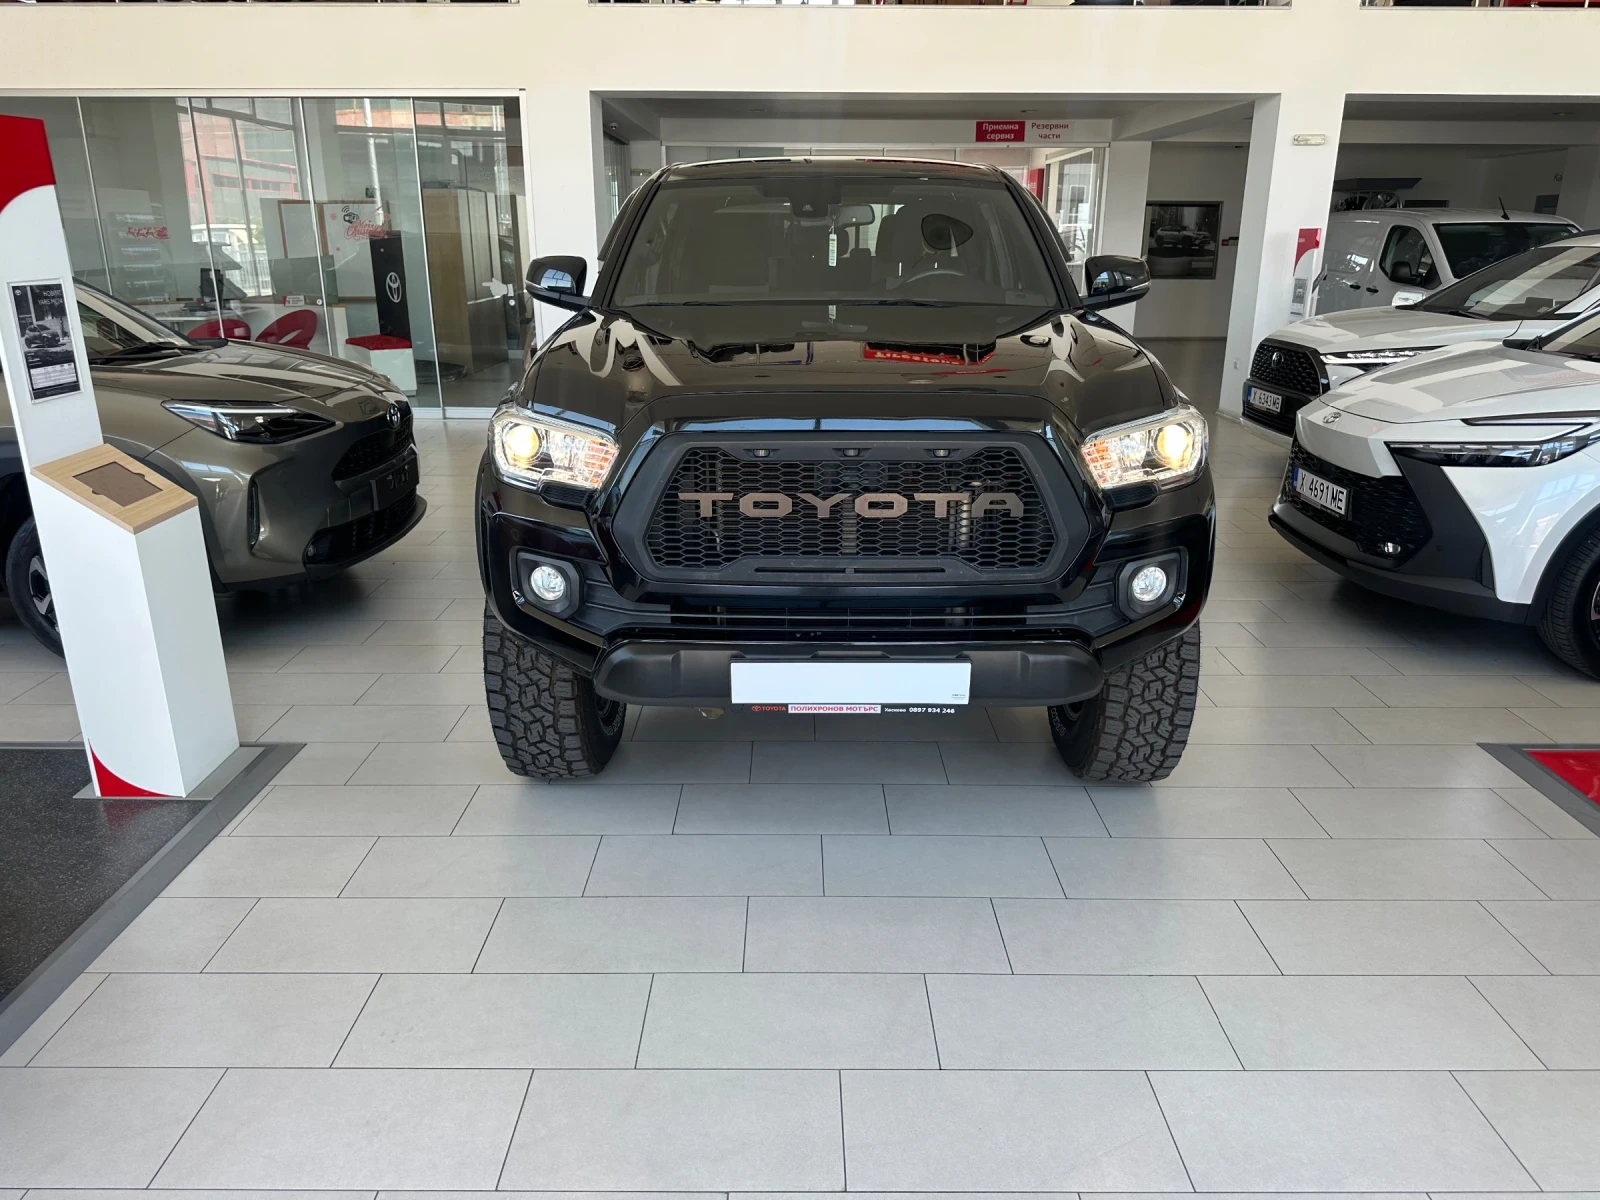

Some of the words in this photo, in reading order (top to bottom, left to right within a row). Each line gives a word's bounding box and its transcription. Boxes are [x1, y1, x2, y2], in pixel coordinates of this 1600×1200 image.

[982, 123, 1019, 132] Приемна
[1031, 122, 1069, 131] Резервни
[986, 132, 1015, 141] сервиз
[1252, 390, 1258, 402] X
[1258, 392, 1272, 407] 6343
[1300, 472, 1306, 493] X
[1309, 477, 1330, 504] 4691
[1331, 487, 1345, 511] ME
[678, 492, 1024, 518] TOYOTA
[845, 705, 879, 713] МОТЪРС
